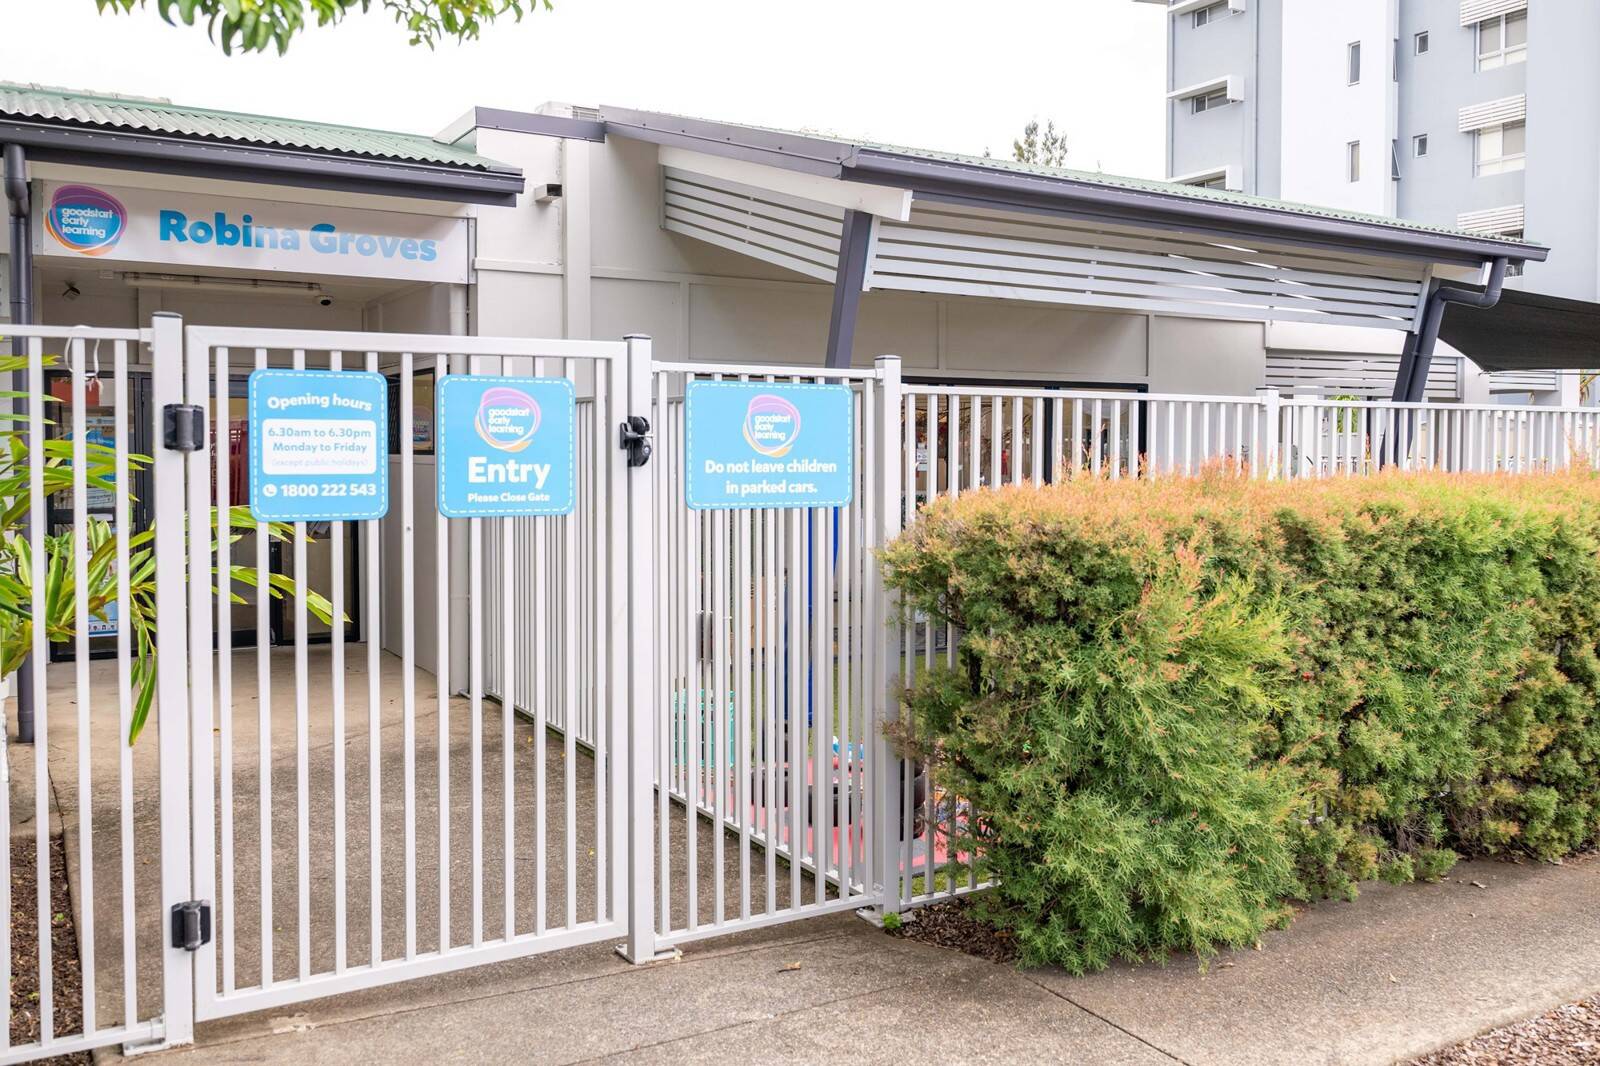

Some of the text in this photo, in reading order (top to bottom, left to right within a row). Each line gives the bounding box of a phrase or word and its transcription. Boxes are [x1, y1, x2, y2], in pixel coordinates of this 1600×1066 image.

[62, 208, 113, 218] goodstart
[62, 216, 89, 227] early
[62, 225, 105, 238] learning
[160, 209, 437, 262] Robina Groves
[267, 392, 373, 411] Opening hours
[488, 408, 530, 418] goodstart
[488, 416, 511, 426] early
[754, 414, 791, 424] goodstart
[268, 427, 372, 439] 6.30am to 6.30pm
[488, 425, 524, 435] learning
[754, 423, 774, 432] early
[754, 431, 786, 441] learning
[273, 442, 367, 453] Monday to Friday
[704, 459, 837, 474] Do not leave children
[468, 456, 551, 490] Entry
[281, 483, 377, 497] 1800 222 543
[726, 480, 818, 497] in parked cars.
[467, 492, 551, 503] Please Close Gate
